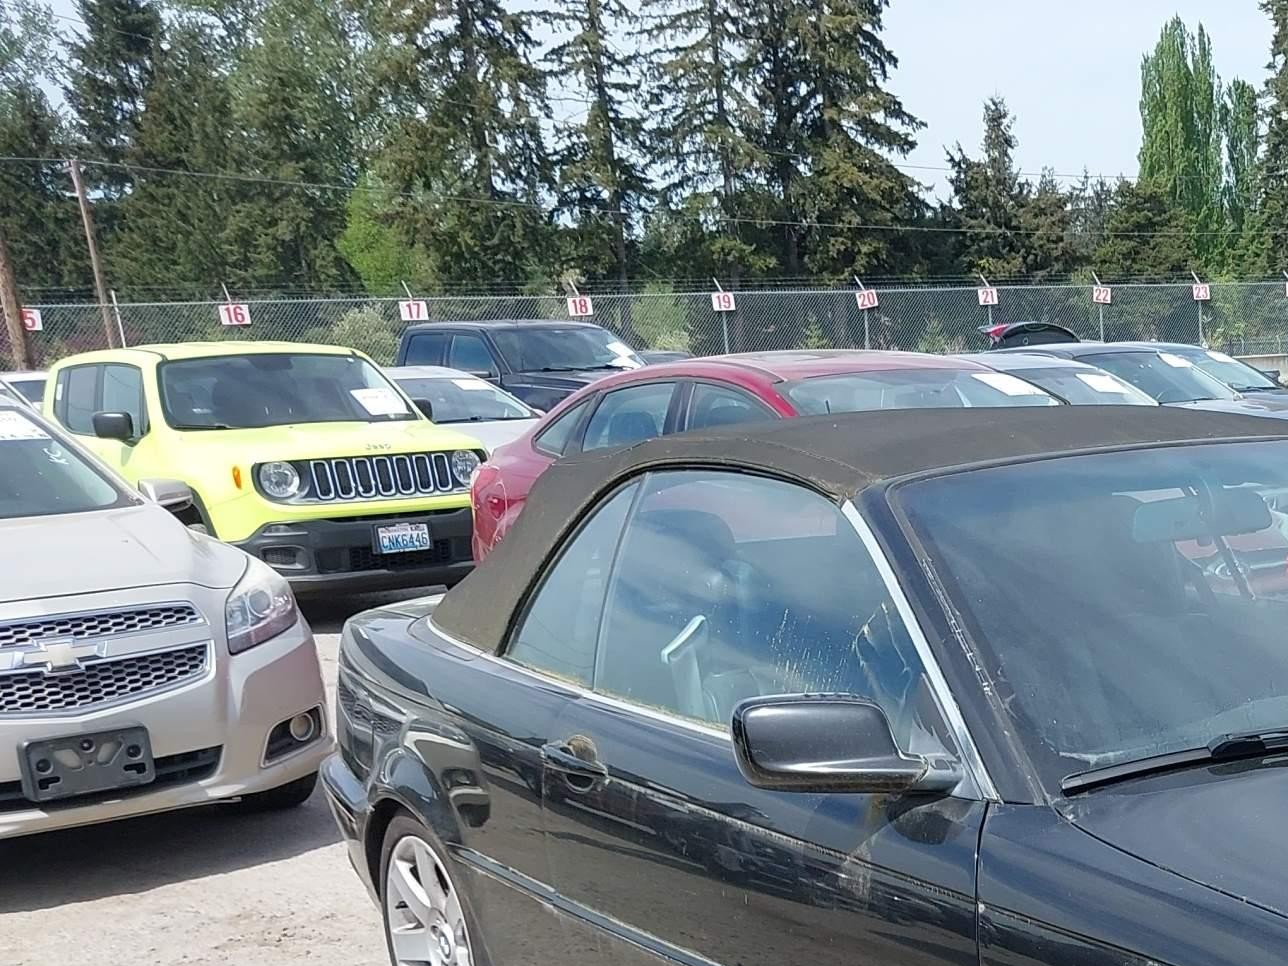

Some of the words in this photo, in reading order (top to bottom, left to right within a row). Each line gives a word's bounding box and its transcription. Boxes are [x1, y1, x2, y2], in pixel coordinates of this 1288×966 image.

[859, 292, 875, 307] 20
[982, 290, 994, 305] 21
[1096, 289, 1109, 302] 22
[1195, 287, 1208, 300] 23
[572, 299, 589, 314] 18
[716, 295, 730, 309] 19
[224, 306, 246, 324] 16
[406, 303, 422, 319] 17
[381, 532, 428, 550] CNK6446
